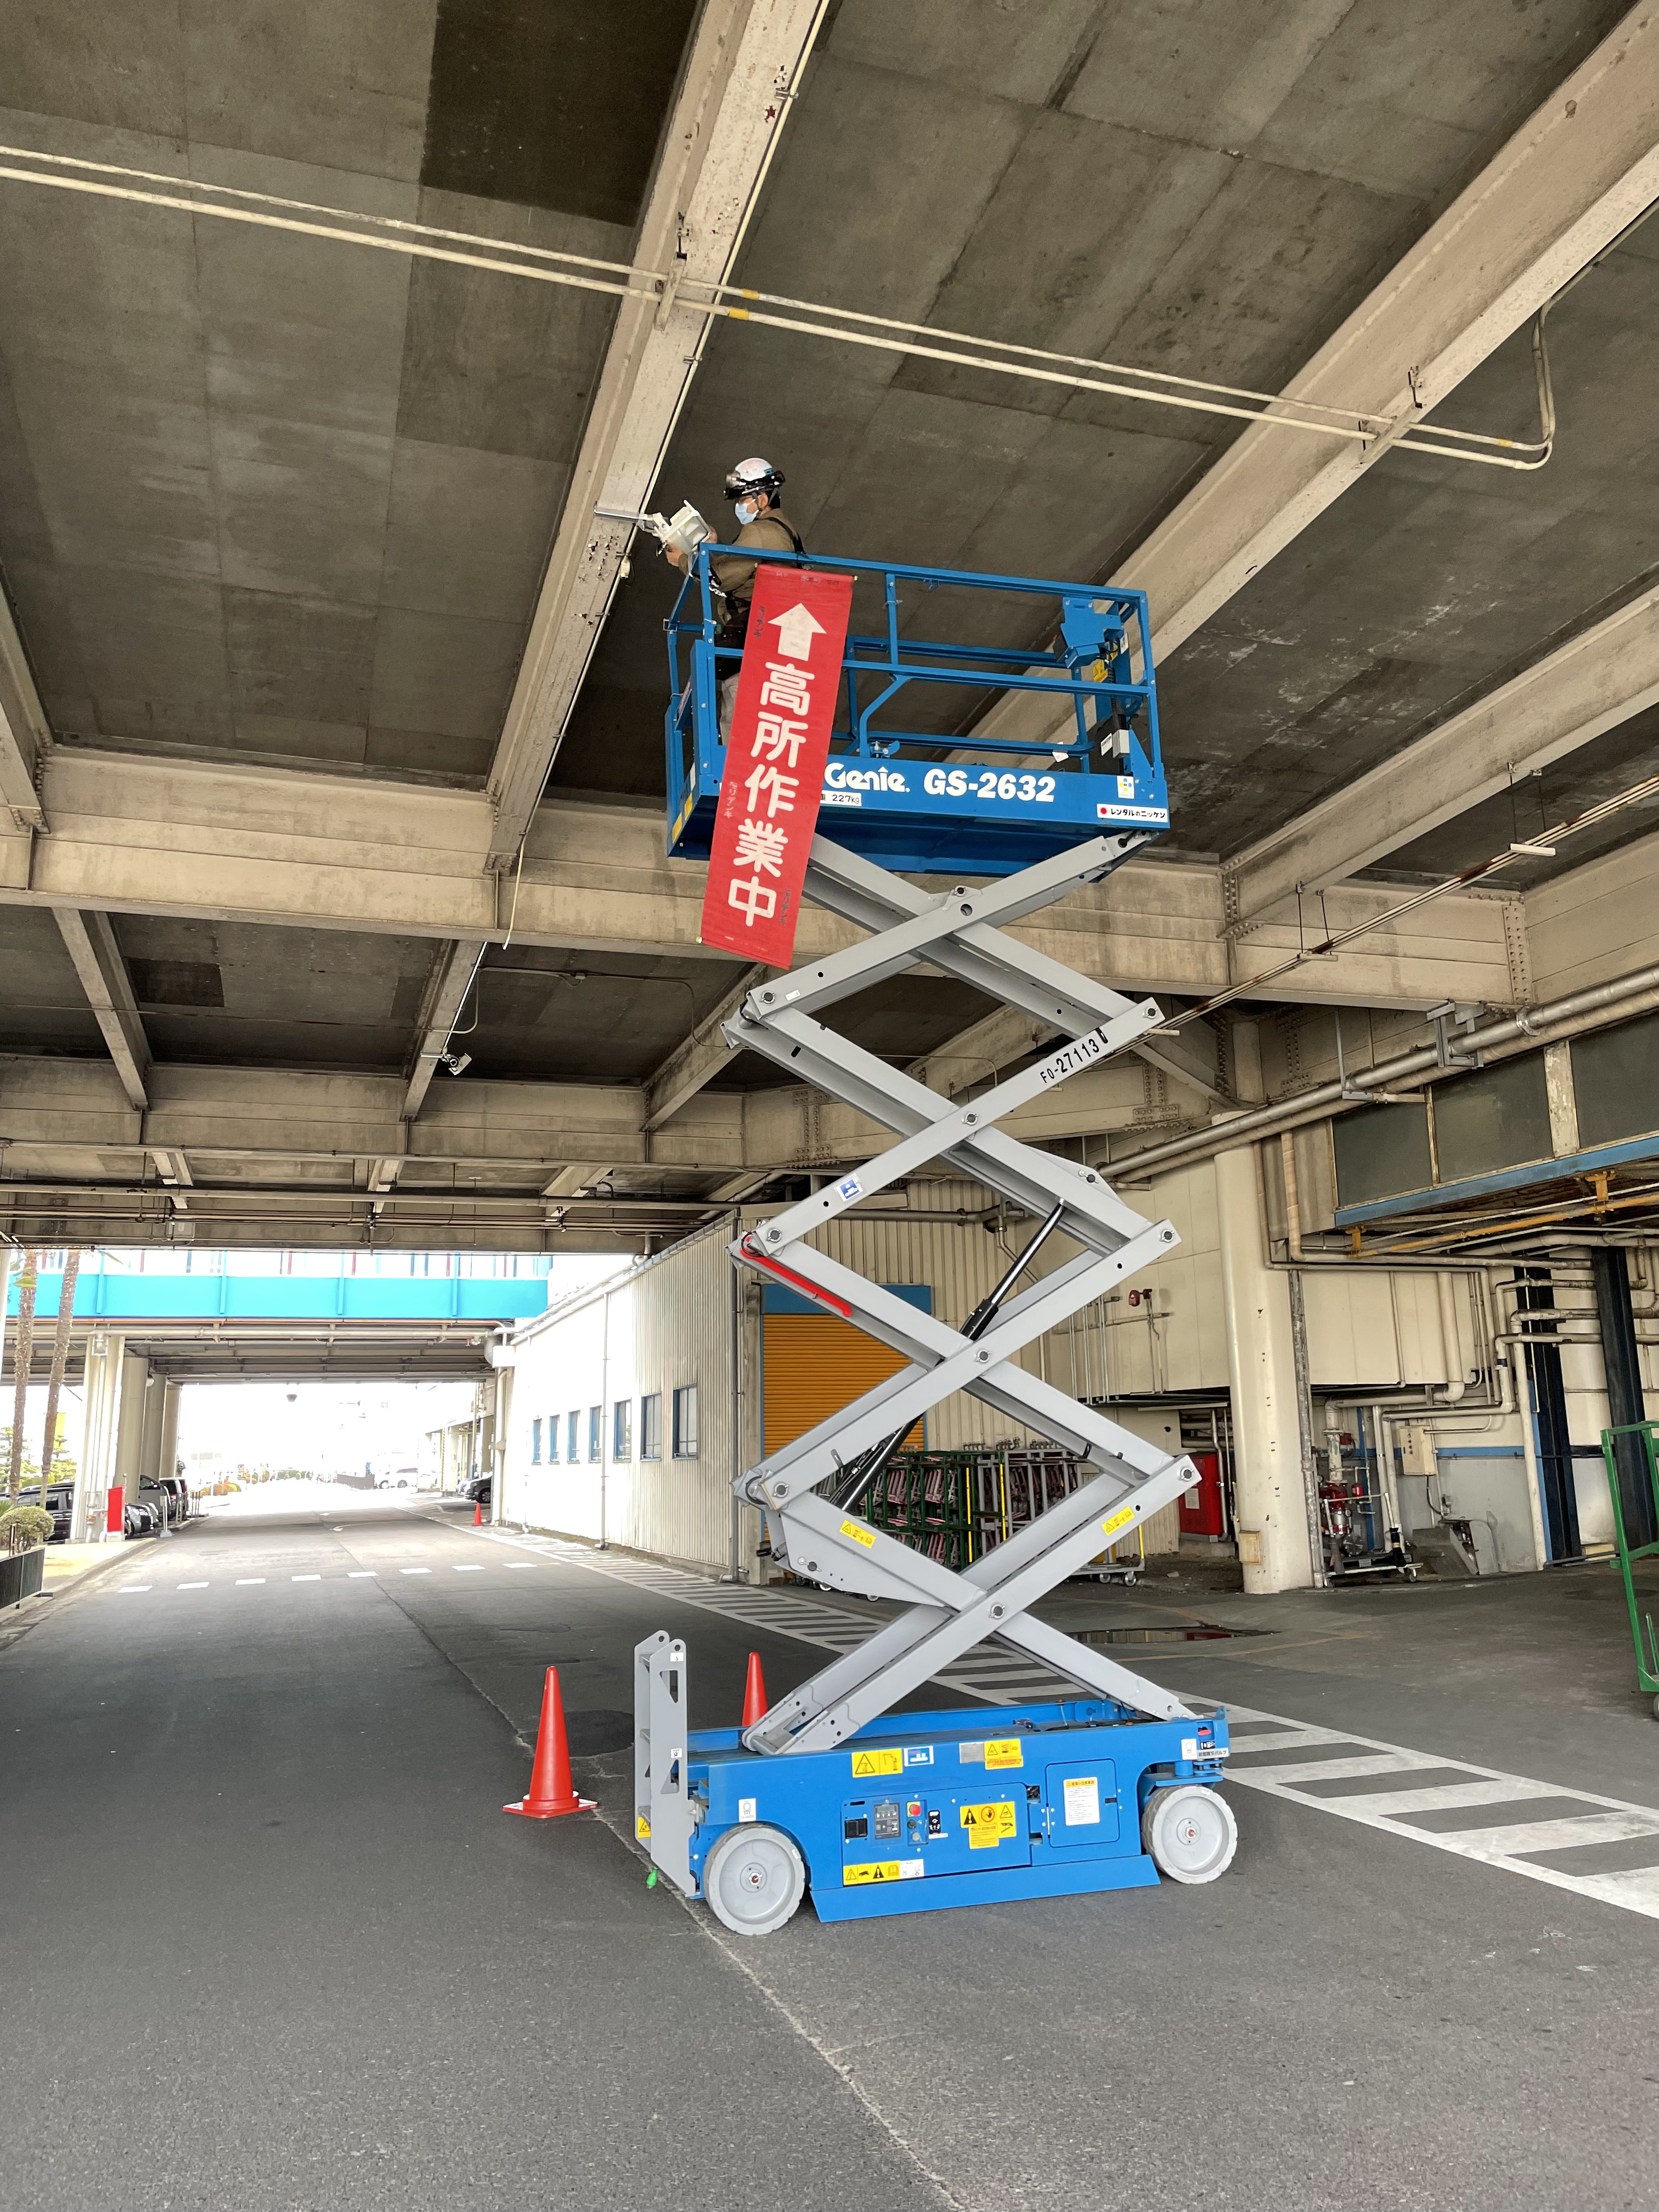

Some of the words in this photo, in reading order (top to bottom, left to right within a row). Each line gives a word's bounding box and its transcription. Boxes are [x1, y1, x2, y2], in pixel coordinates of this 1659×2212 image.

[727, 661, 815, 927] 高所作業中
[824, 762, 906, 793] Genie
[923, 768, 1056, 803] GS-2632
[832, 794, 860, 804] 227kg
[1110, 808, 1166, 819] レンタルのニッケン
